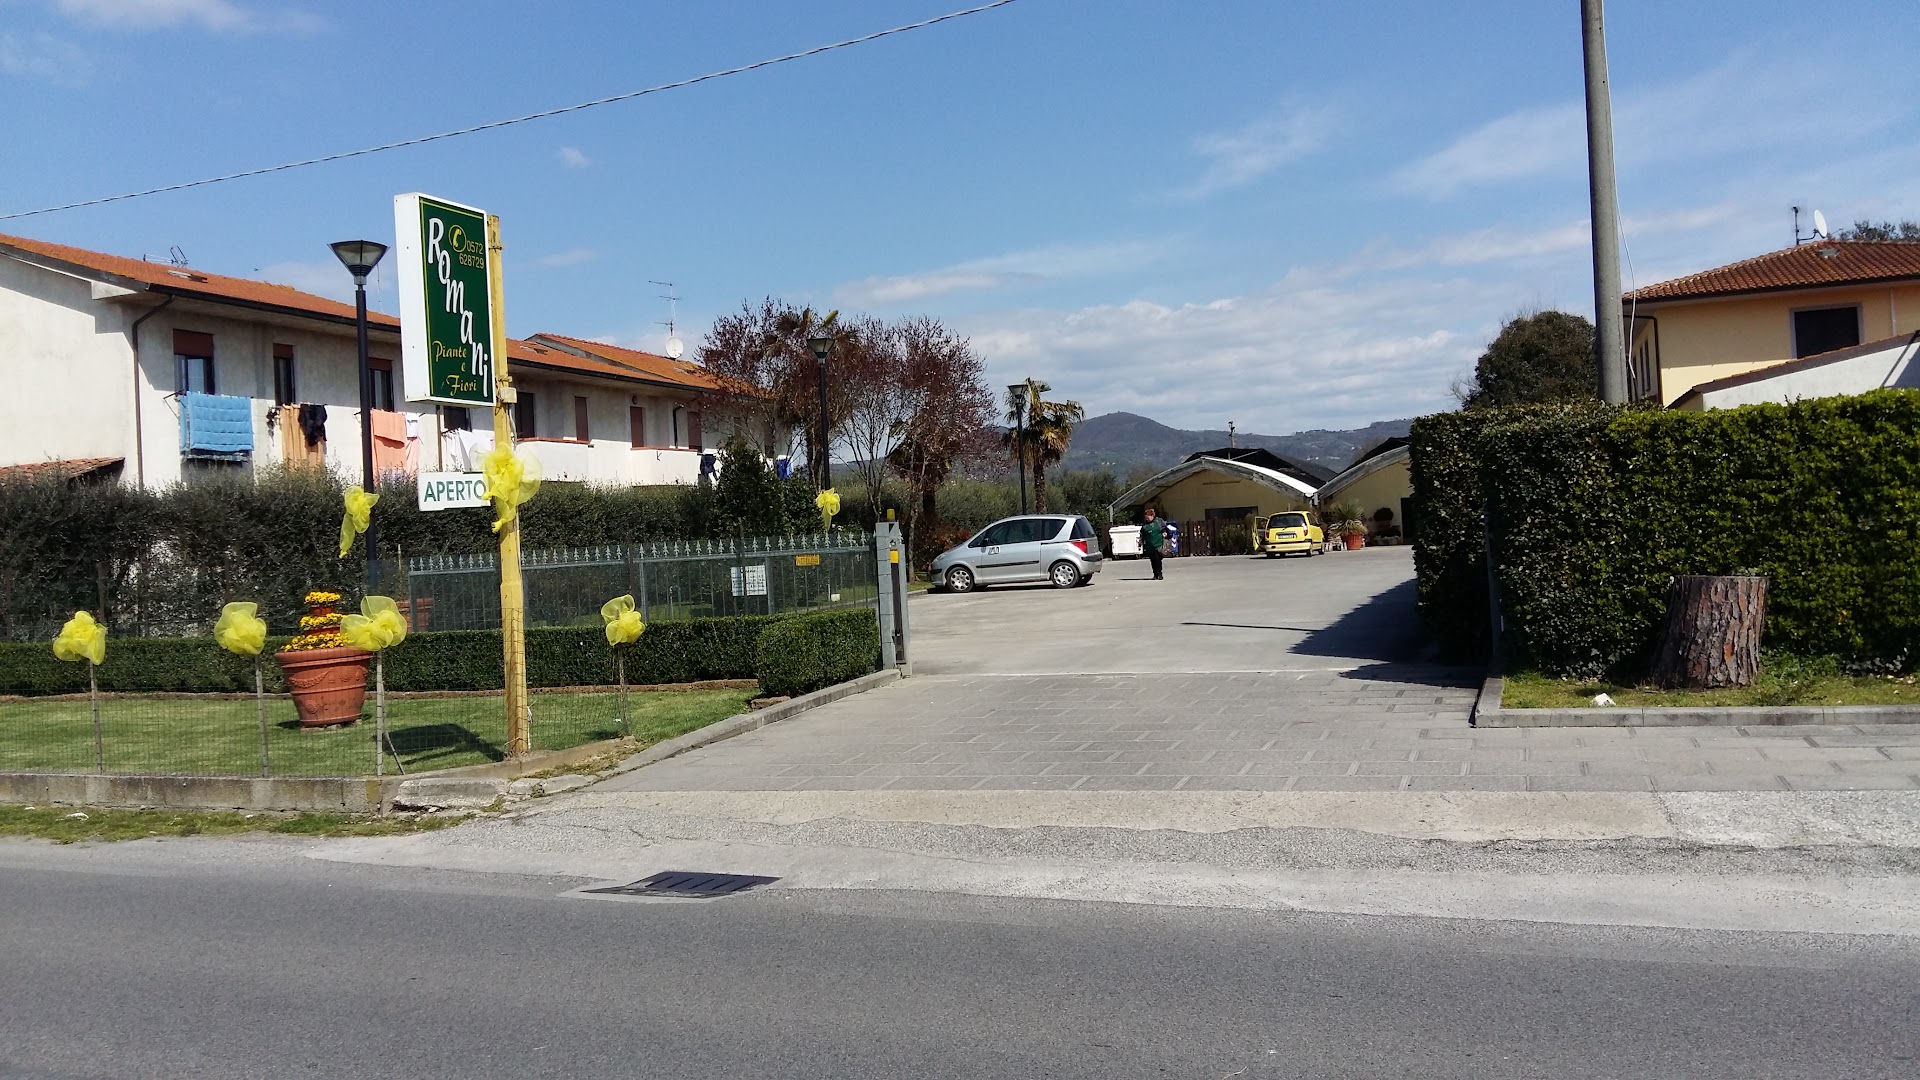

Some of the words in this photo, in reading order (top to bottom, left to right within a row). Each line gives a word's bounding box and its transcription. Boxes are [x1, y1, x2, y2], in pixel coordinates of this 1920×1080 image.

[466, 240, 484, 255] 0572
[459, 253, 485, 269] 628729
[427, 217, 489, 398] Romani
[431, 340, 467, 363] Piante
[461, 362, 466, 372] e
[446, 374, 477, 397] Fiori
[423, 479, 487, 503] APERTO
